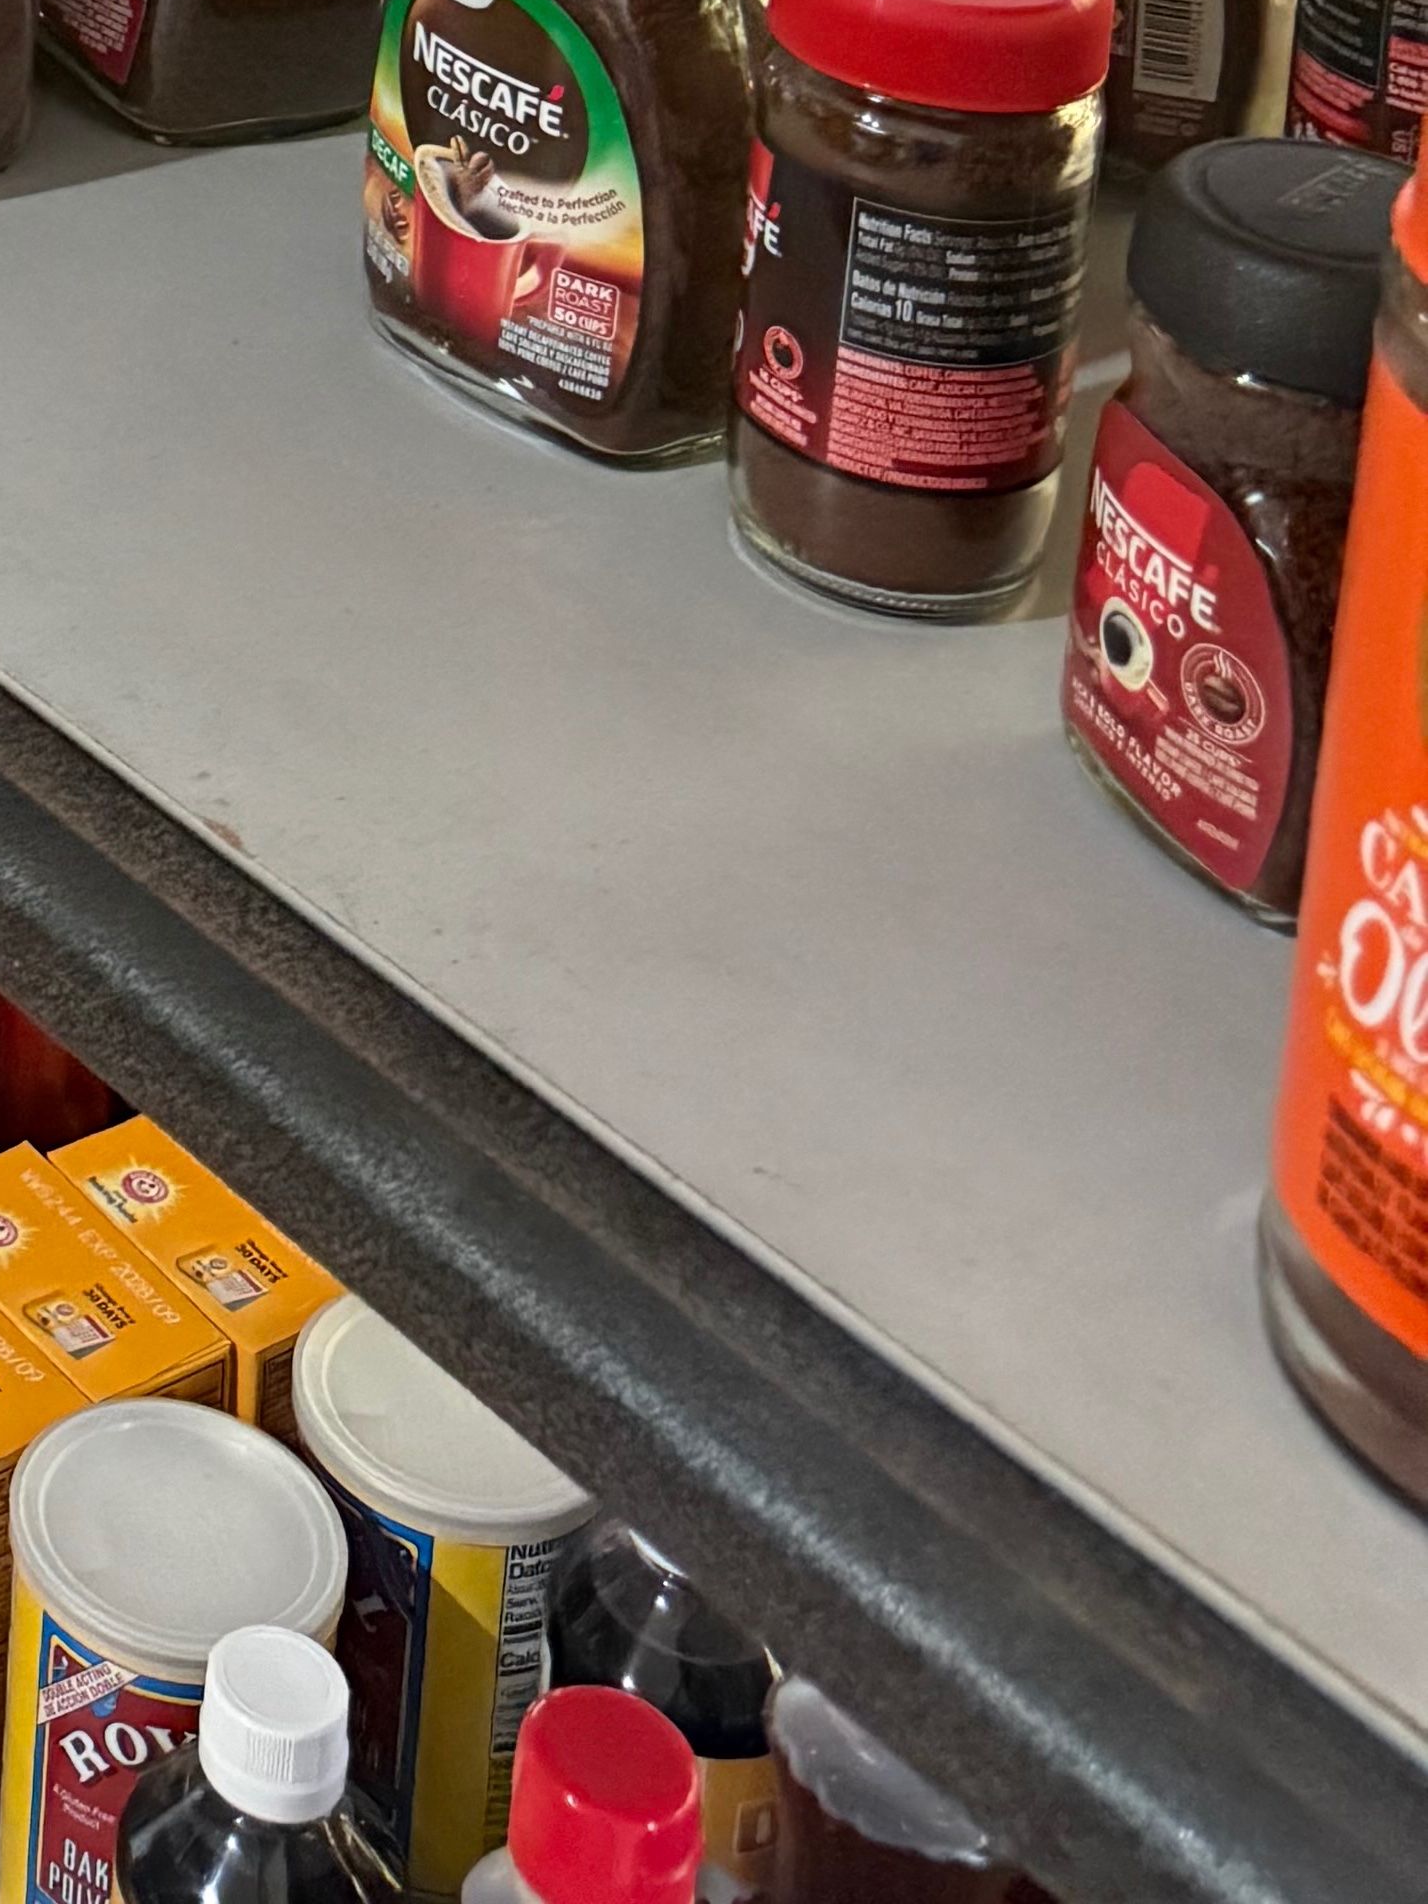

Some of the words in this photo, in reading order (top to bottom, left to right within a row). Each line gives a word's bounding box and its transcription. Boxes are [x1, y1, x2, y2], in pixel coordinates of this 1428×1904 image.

[412, 20, 565, 139] NESCAFÉ
[426, 84, 531, 156] CLÁSICO
[370, 128, 411, 181] DECAF
[496, 185, 539, 207] Crafted
[541, 195, 555, 209] to
[556, 187, 618, 211] Perfection
[496, 197, 534, 219] Hecho
[546, 209, 559, 225] la
[560, 198, 627, 227] Perfección
[903, 223, 933, 245] Facts
[554, 287, 613, 315] ROAST
[556, 272, 615, 303] DARK
[553, 307, 578, 326] 50
[895, 299, 914, 323] 10
[1089, 467, 1220, 635] NESCAFÉ
[1095, 538, 1187, 641] CLÁSICO
[1184, 679, 1216, 734] DARK
[1213, 717, 1259, 744] ROAST
[1128, 732, 1183, 799] FLAVOR
[247, 1255, 281, 1285] DAYS
[81, 1285, 103, 1307] 30
[95, 1299, 130, 1332] DAYS
[42, 1680, 74, 1704] DOUBLE
[75, 1664, 112, 1688] ACTING
[90, 1671, 125, 1699] DOBLE
